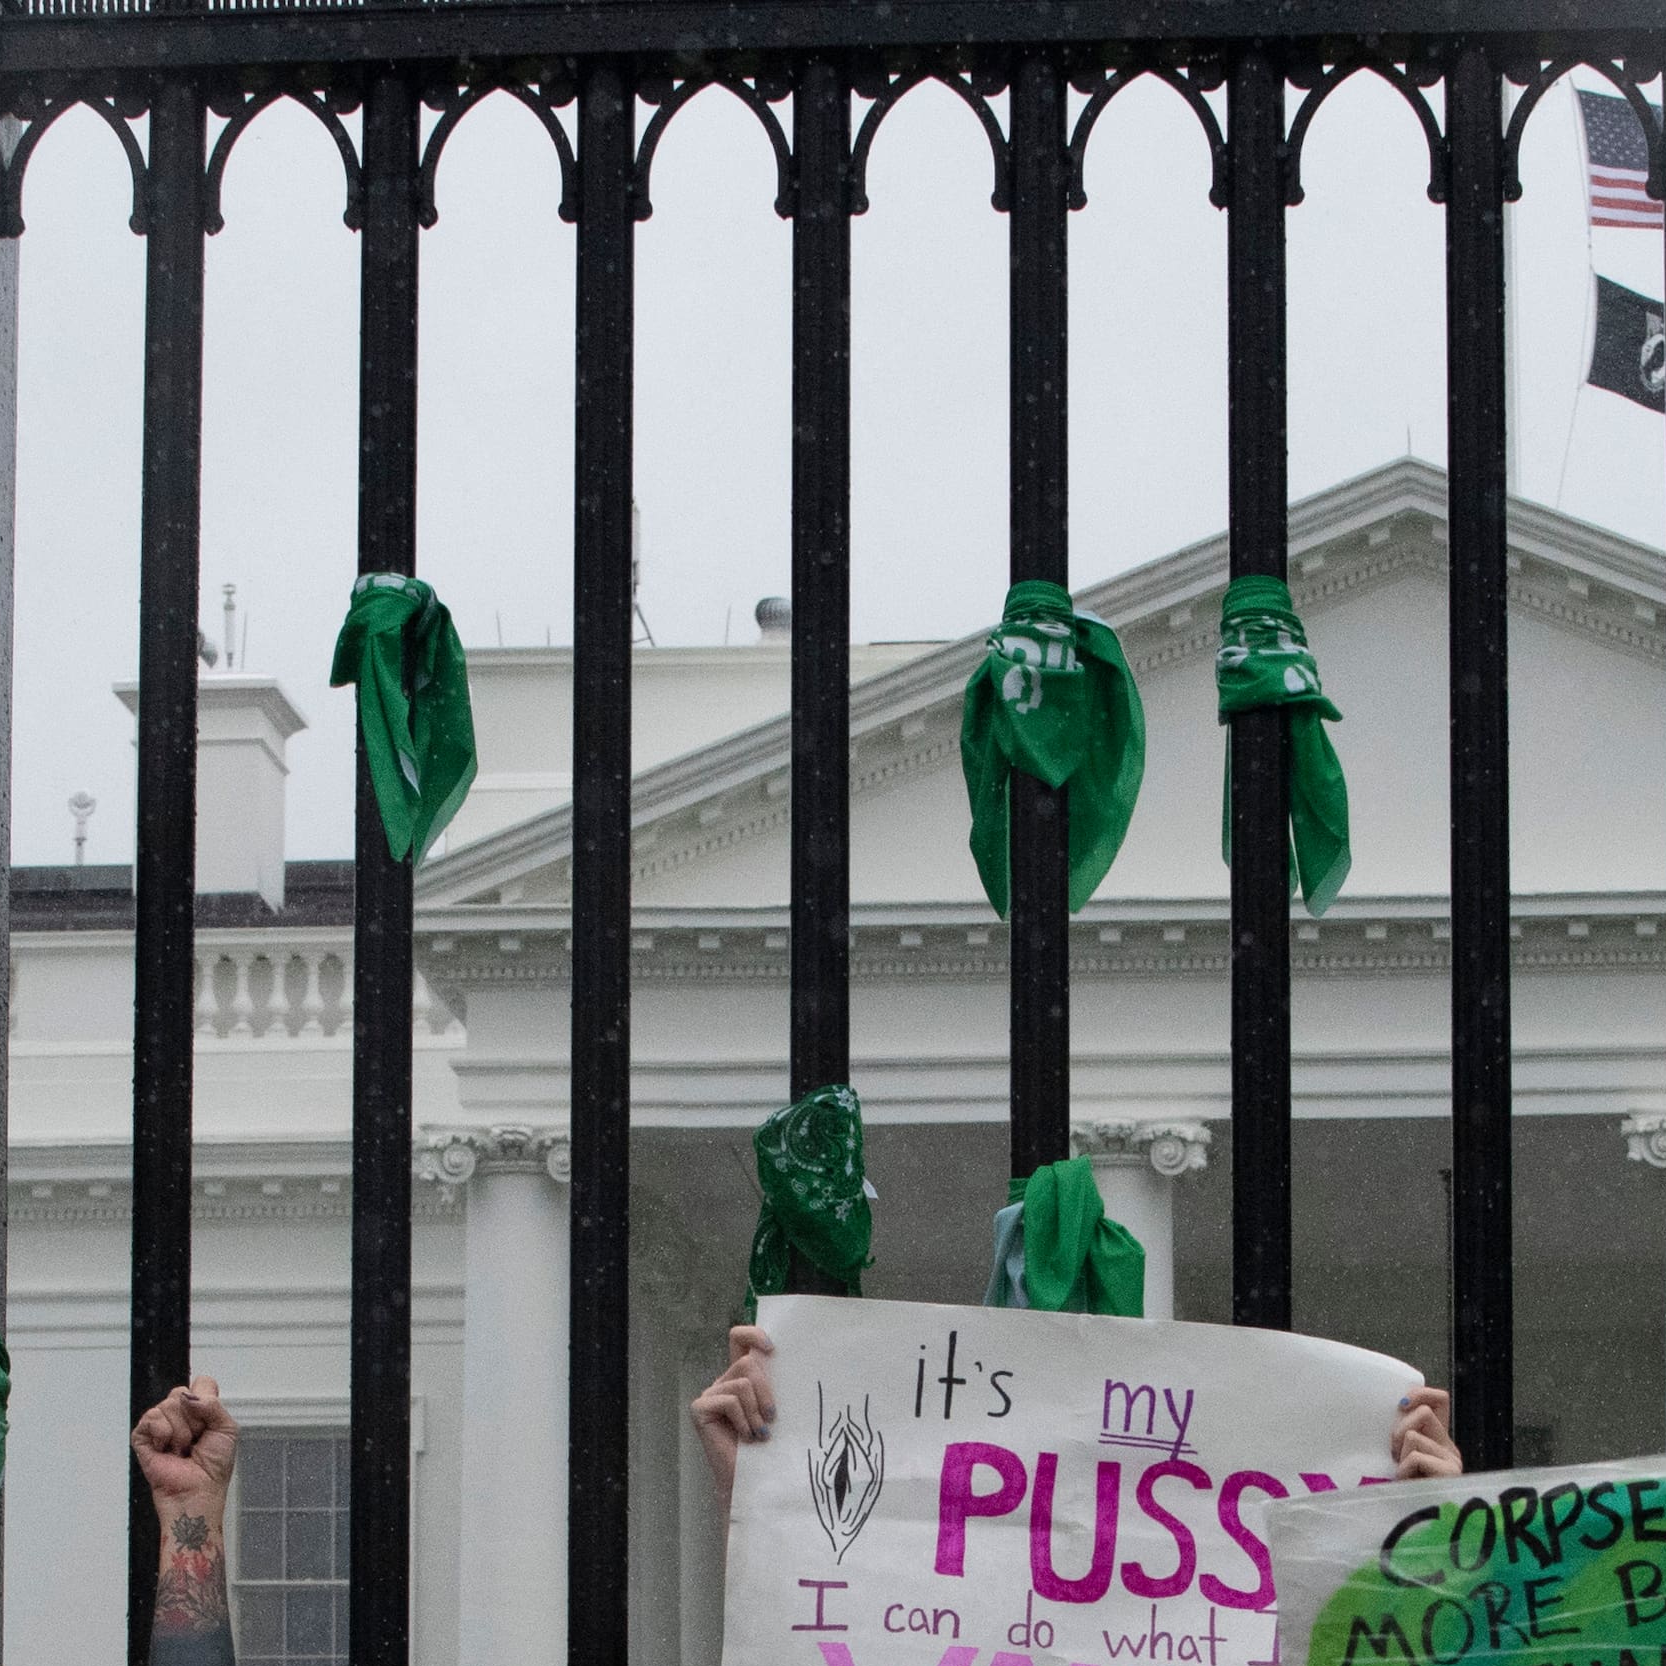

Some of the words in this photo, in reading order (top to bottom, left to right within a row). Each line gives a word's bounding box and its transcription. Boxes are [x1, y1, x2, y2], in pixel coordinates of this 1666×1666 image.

[915, 1331, 1013, 1419] it's
[1102, 1378, 1195, 1461] my
[935, 1442, 1395, 1610] PUSS
[792, 1579, 848, 1631] I
[884, 1601, 960, 1638] can
[1008, 1590, 1055, 1648] do
[1103, 1606, 1228, 1666] what
